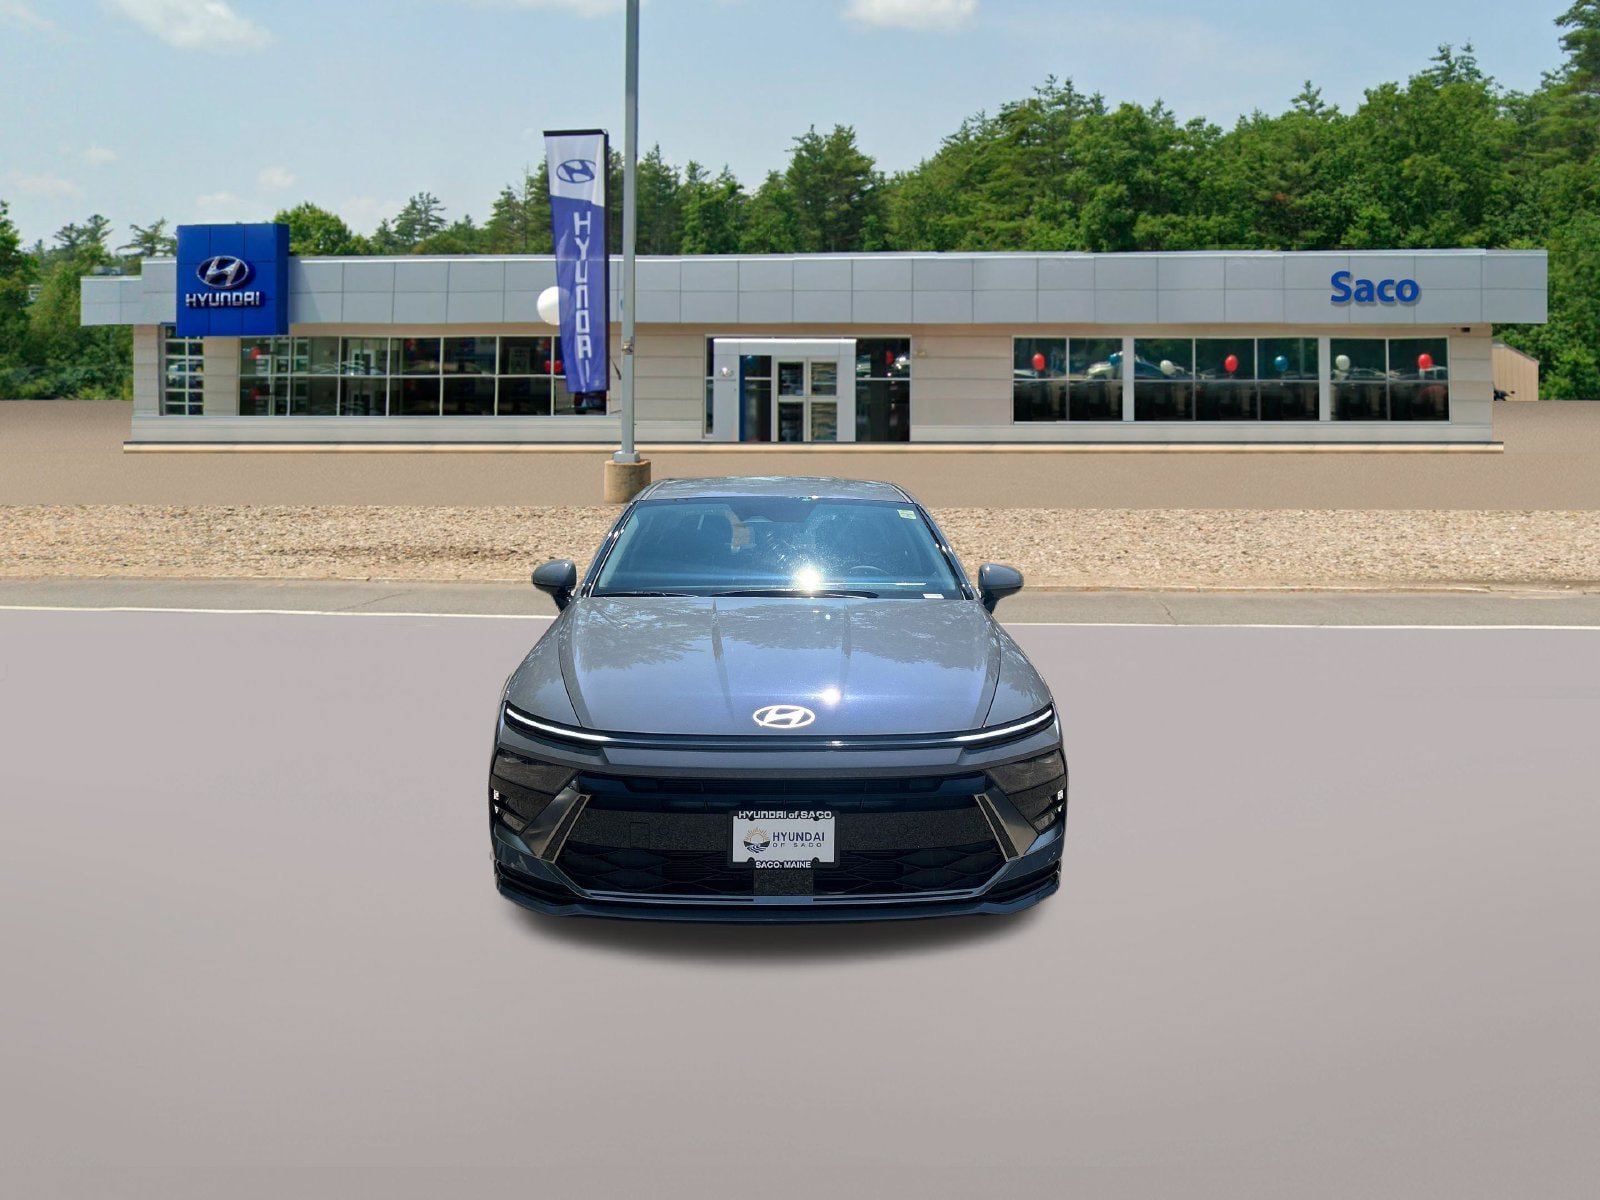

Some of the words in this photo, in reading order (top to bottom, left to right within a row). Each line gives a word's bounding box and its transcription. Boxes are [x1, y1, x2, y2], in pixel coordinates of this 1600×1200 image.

[1330, 270, 1420, 303] Saco
[185, 291, 260, 307] HYUNDAI
[573, 211, 592, 383] HYUNDAI
[738, 811, 787, 819] HYUNDAI
[788, 811, 799, 819] of
[800, 811, 832, 819] SACO
[772, 832, 825, 841] HYUNDAI
[783, 861, 812, 869] MAINE
